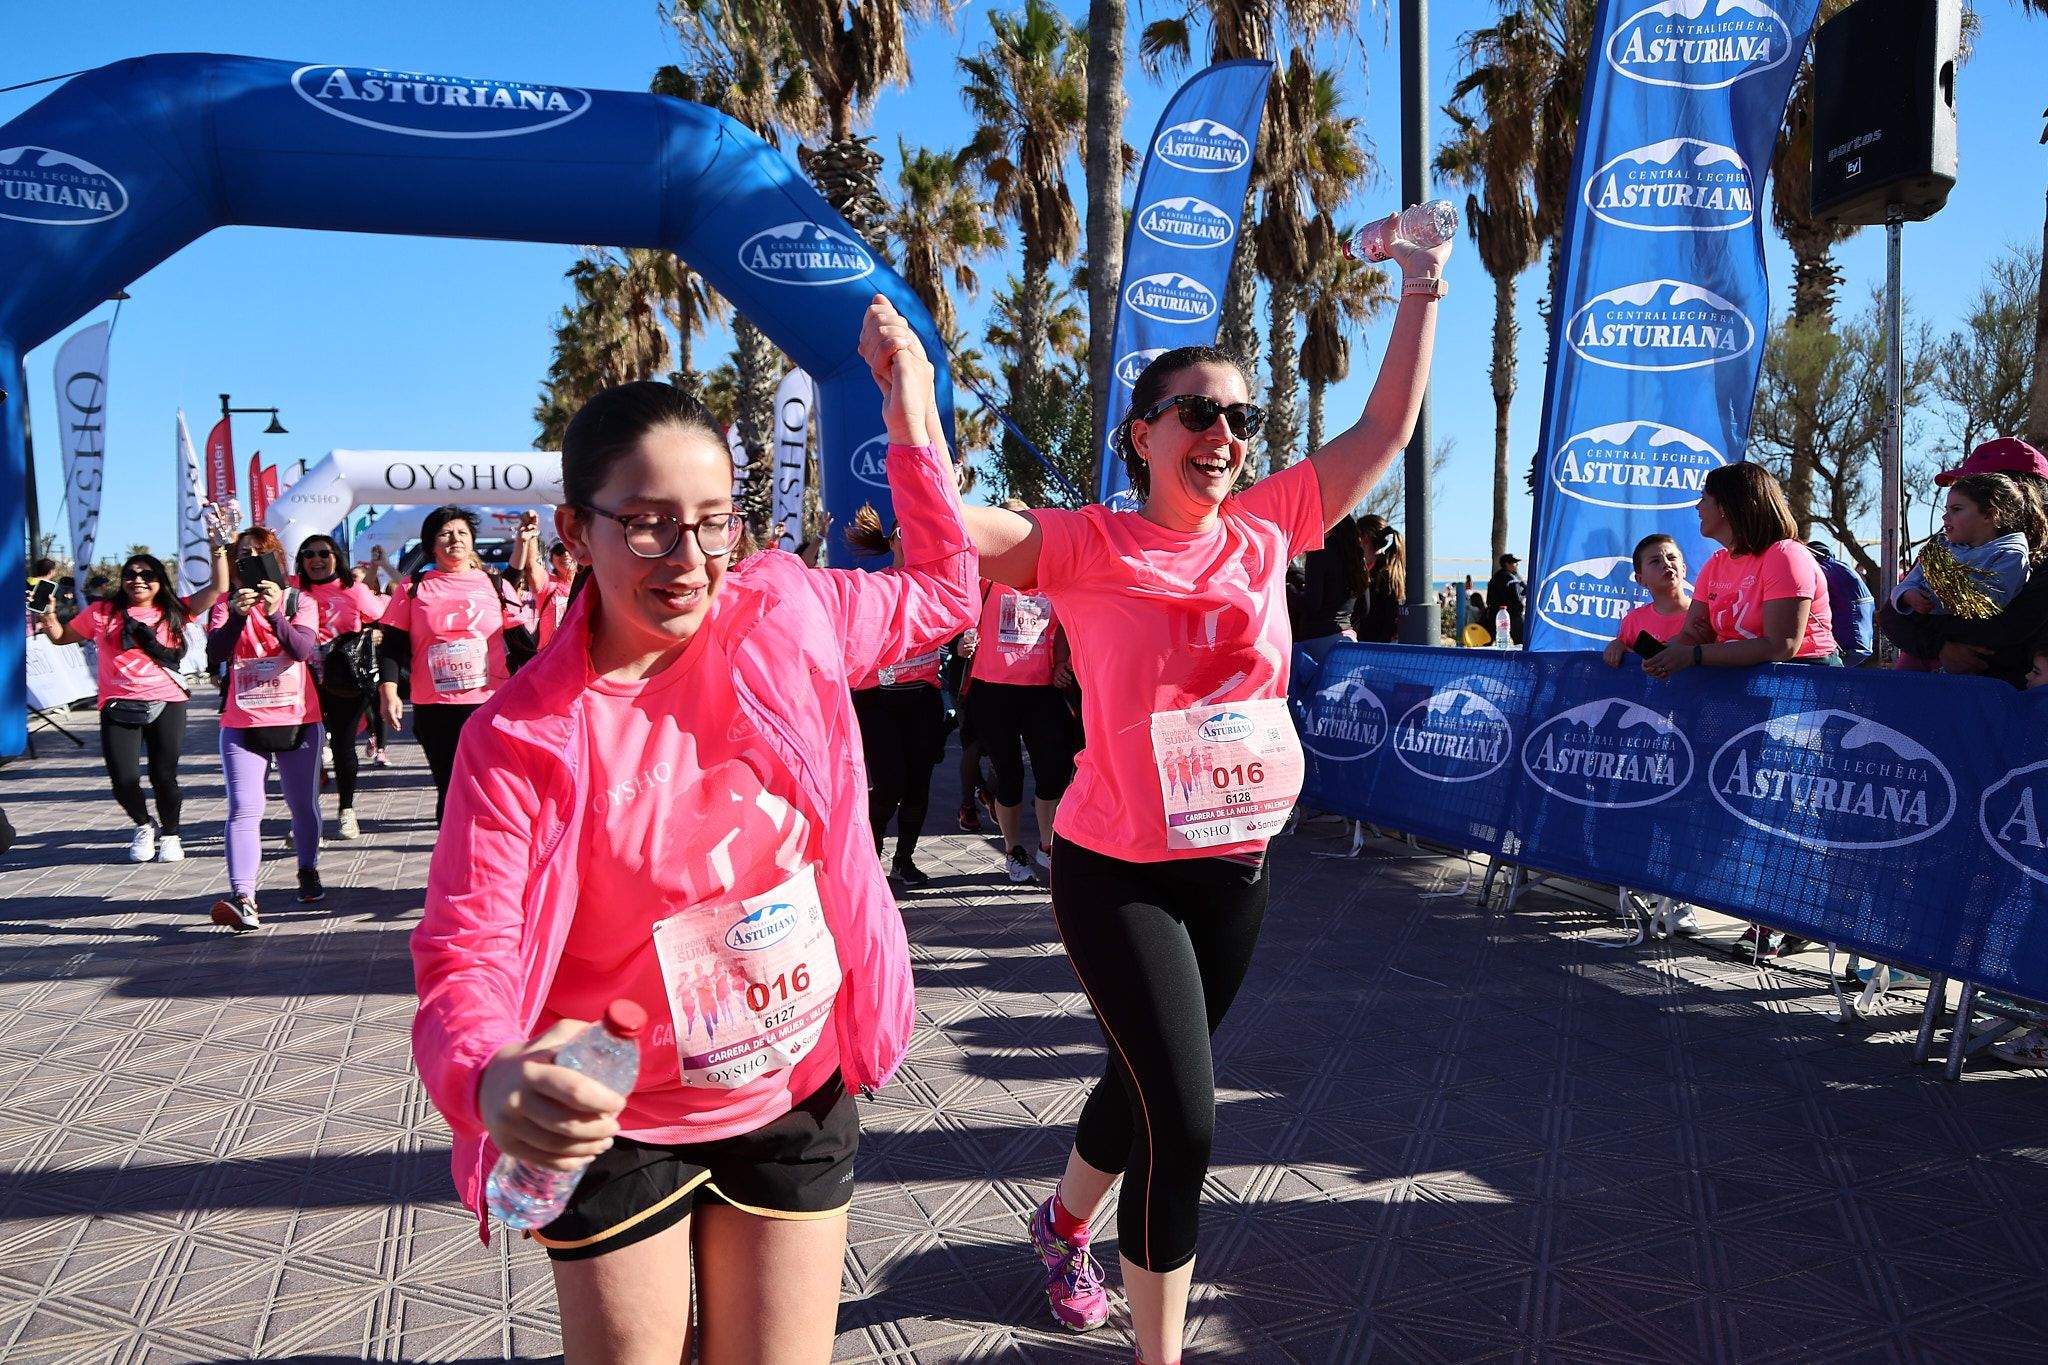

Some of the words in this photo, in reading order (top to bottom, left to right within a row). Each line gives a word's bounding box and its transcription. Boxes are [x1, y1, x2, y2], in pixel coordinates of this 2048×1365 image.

[1655, 24, 1715, 35] CENTRAL
[1620, 27, 1772, 65] ASTURIANA
[316, 68, 573, 112] ASTURIANA
[1161, 135, 1242, 163] ASTURIANA
[43, 172, 107, 187] LECHERA
[1629, 169, 1690, 180] CENTRAL
[0, 180, 114, 212] URIANA
[1144, 211, 1226, 240] ASTURIANA
[751, 244, 868, 270] ASTURIANA
[771, 242, 814, 250] CENTRAL
[1132, 286, 1208, 315] ASTURIANA
[1607, 311, 1668, 321] CENTRAL
[1672, 311, 1735, 324] LECHERA
[1578, 313, 1737, 351] ASTURIANA
[1586, 449, 1647, 461] CENTRAL
[1653, 452, 1711, 465] LECHERA
[384, 463, 533, 491] OYSHO
[291, 494, 339, 504] OYSHO
[1543, 582, 1645, 620] ASTUR
[1569, 581, 1627, 595] CENTRAL
[450, 661, 472, 672] 016
[1164, 734, 1195, 746] SUMA
[1400, 719, 1502, 763] ASTURIANA
[1563, 732, 1615, 747] CENTRAL
[1619, 736, 1676, 751] LECHERA
[1532, 733, 1676, 786] ASTURIANA
[1761, 749, 1836, 770] CENTRAL
[1844, 759, 1929, 783] LECHERA
[593, 761, 672, 814] OYSHO
[1212, 762, 1265, 789] 016
[1721, 749, 1930, 827] ASTURIANA
[1225, 792, 1251, 805] 6128
[1185, 811, 1215, 823] CARRERA
[1216, 809, 1226, 818] DE
[1226, 806, 1235, 816] LA
[1236, 804, 1259, 815] MUJER
[1185, 824, 1230, 841] OYSHO
[746, 962, 810, 1012] 016
[765, 1005, 795, 1029] 6127
[707, 1042, 751, 1064] CARRERA
[752, 1038, 765, 1050] DE
[766, 1032, 777, 1044] LA
[707, 1054, 768, 1083] OYSHO
